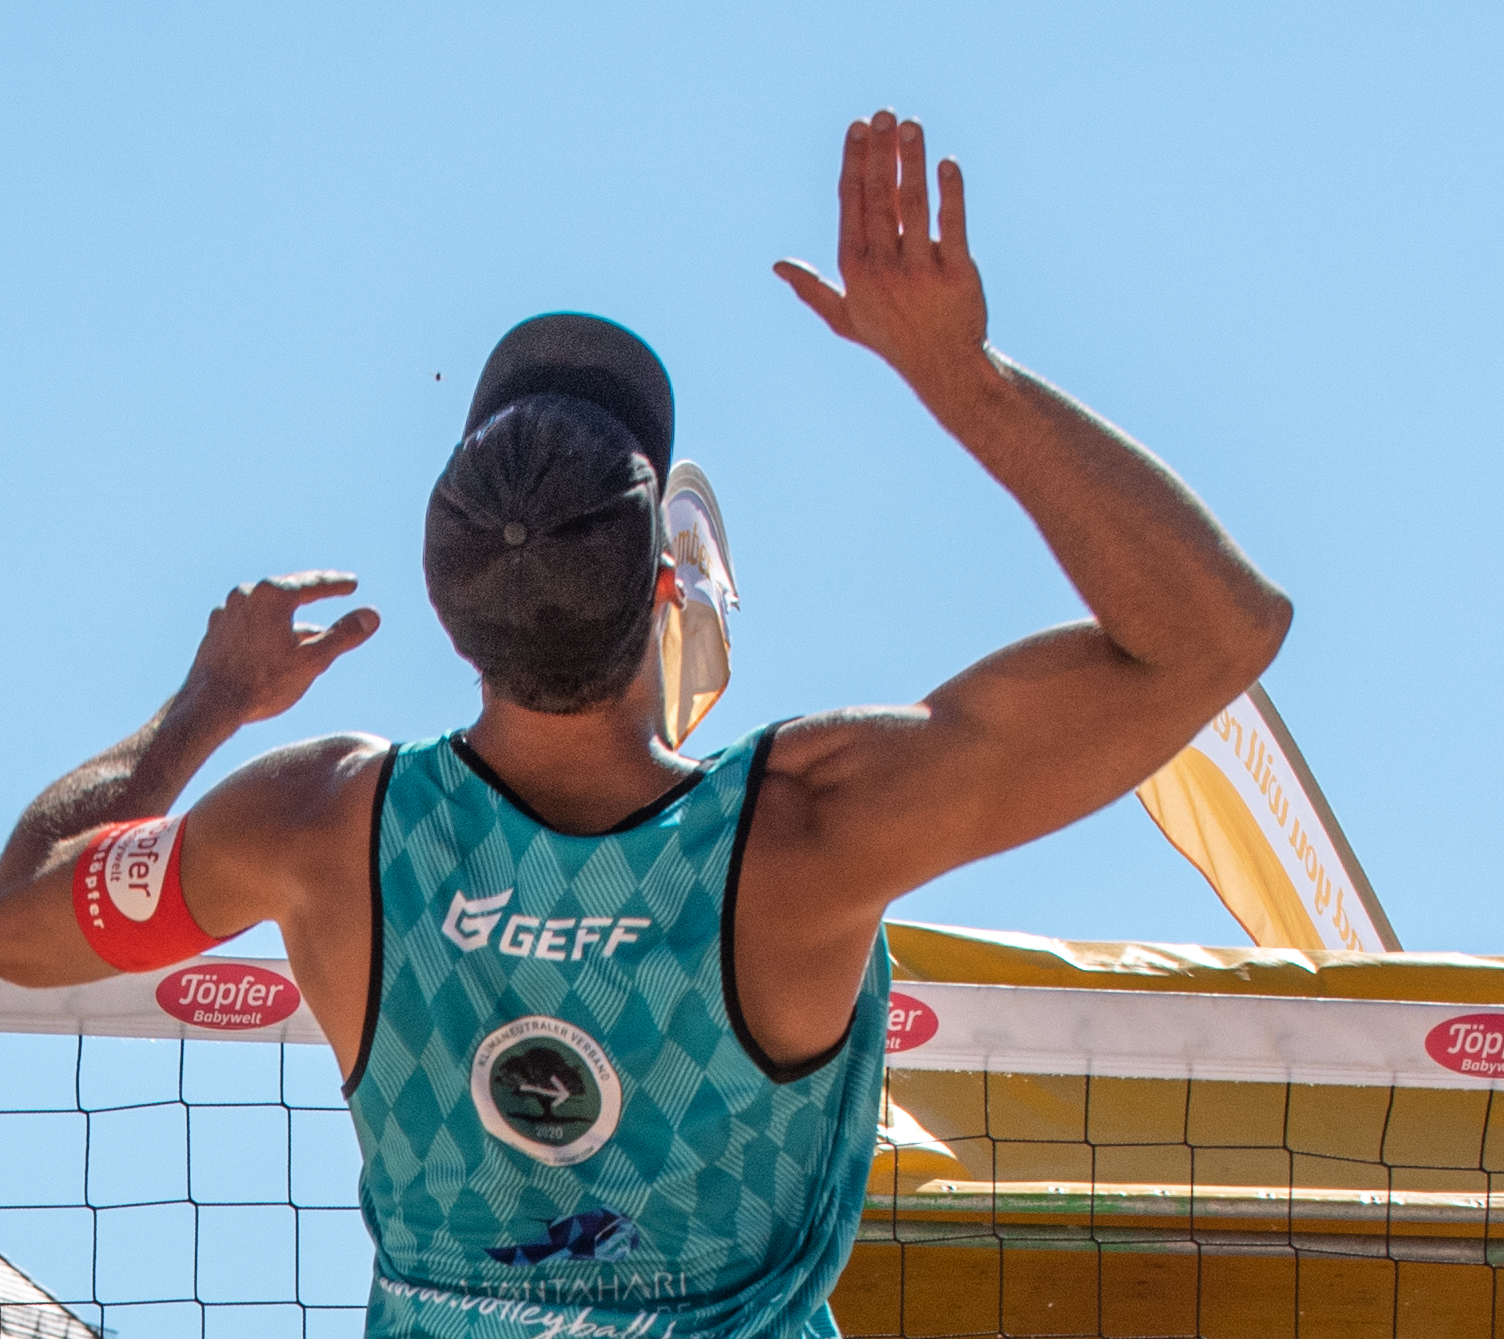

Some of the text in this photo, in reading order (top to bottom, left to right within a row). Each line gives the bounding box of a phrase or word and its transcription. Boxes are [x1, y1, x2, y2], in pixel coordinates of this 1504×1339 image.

[498, 914, 652, 962] GEFF
[178, 963, 284, 1009] Töpfer
[193, 1009, 263, 1027] Babywelt
[477, 1019, 610, 1082] KLIMANEUTRALER VERBAND
[535, 1125, 564, 1140] 2020
